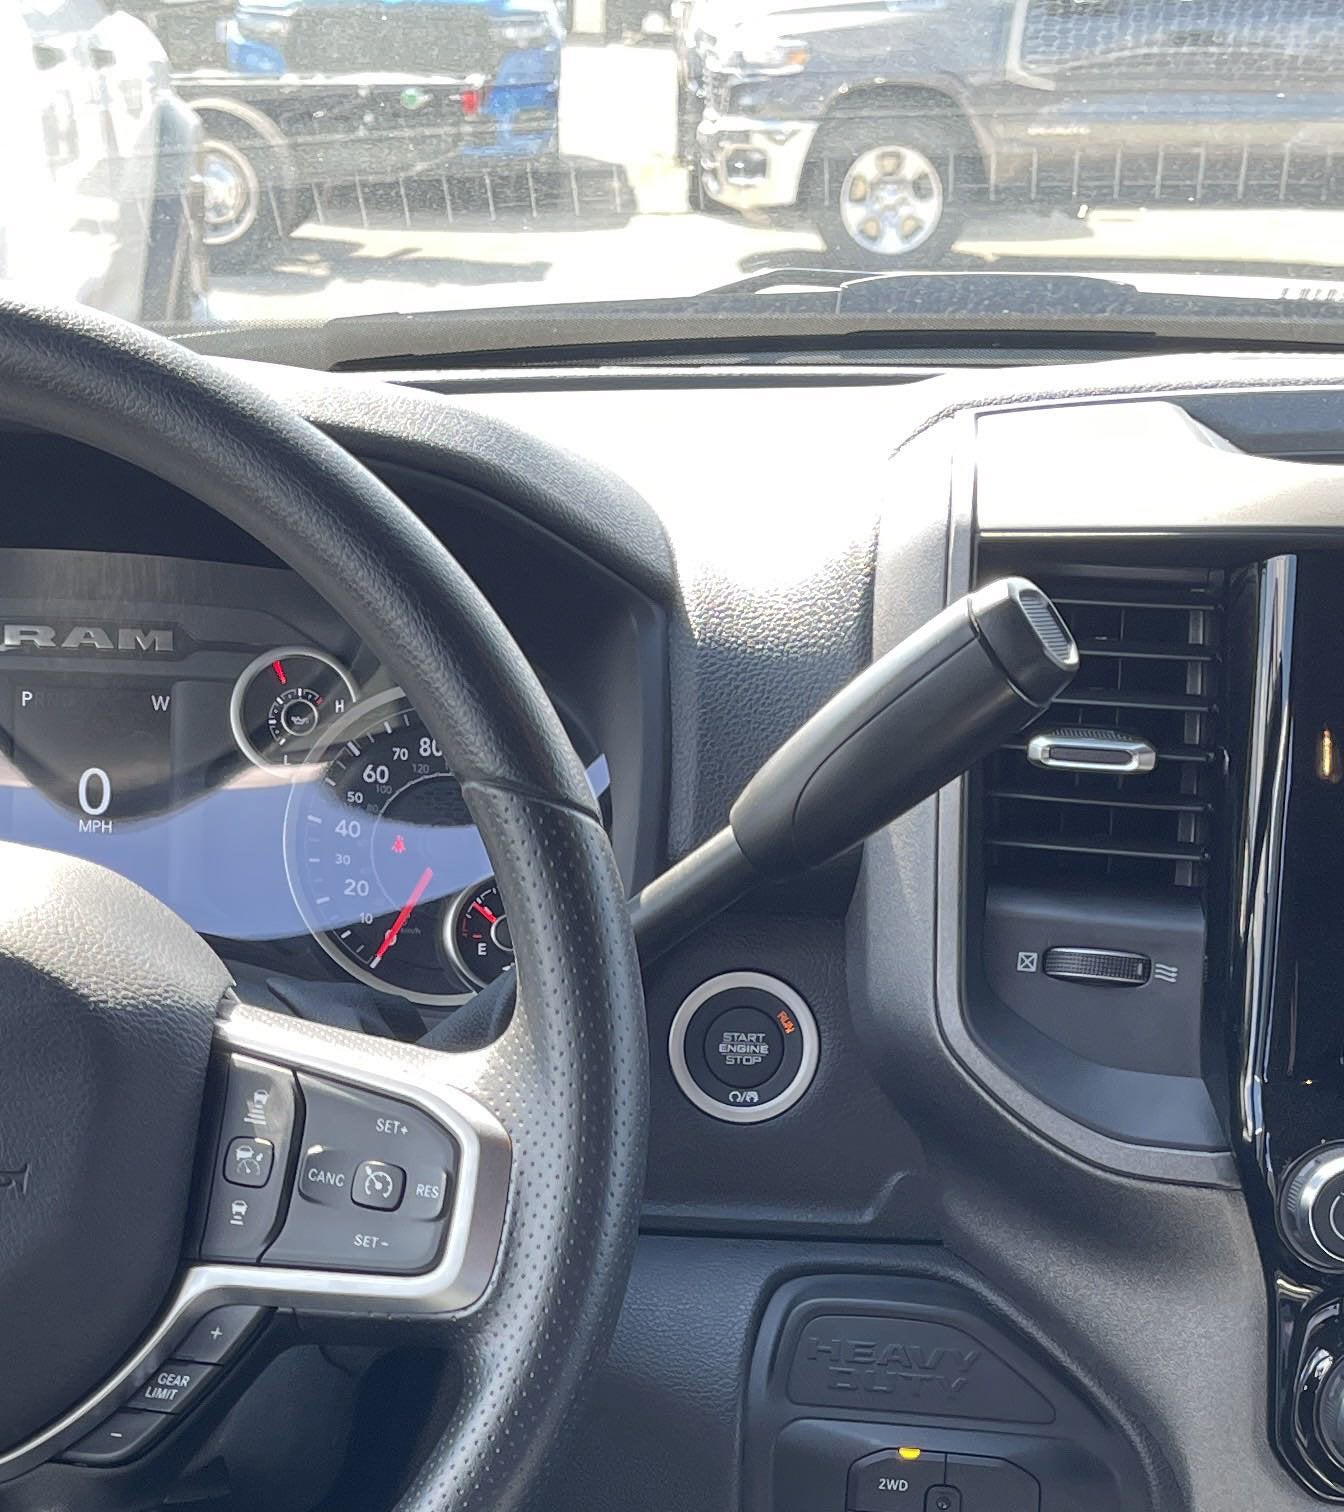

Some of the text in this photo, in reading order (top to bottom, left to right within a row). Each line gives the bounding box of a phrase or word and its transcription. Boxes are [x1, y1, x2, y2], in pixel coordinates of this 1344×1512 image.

[3, 624, 174, 651] RAM
[21, 691, 33, 706] P
[151, 695, 170, 711] W
[335, 699, 344, 713] H
[392, 748, 408, 760] 70
[363, 764, 389, 784] 60
[78, 767, 111, 815] 0
[347, 791, 364, 804] 50
[79, 820, 113, 833] MPH
[335, 820, 361, 839] 40
[336, 854, 351, 865] 30
[344, 879, 369, 896] 20
[360, 913, 373, 924] 10
[478, 943, 487, 955] E
[777, 1010, 795, 1034] RUN
[723, 1032, 766, 1043] START
[718, 1043, 769, 1054] ENGINE
[725, 1055, 762, 1065] STOP
[308, 1168, 345, 1188] CANC
[416, 1183, 439, 1198] RES
[807, 1337, 983, 1370] HEAVY
[158, 1372, 190, 1387] GEAR
[145, 1385, 179, 1400] LIMIT
[878, 1478, 908, 1492] 2WD
